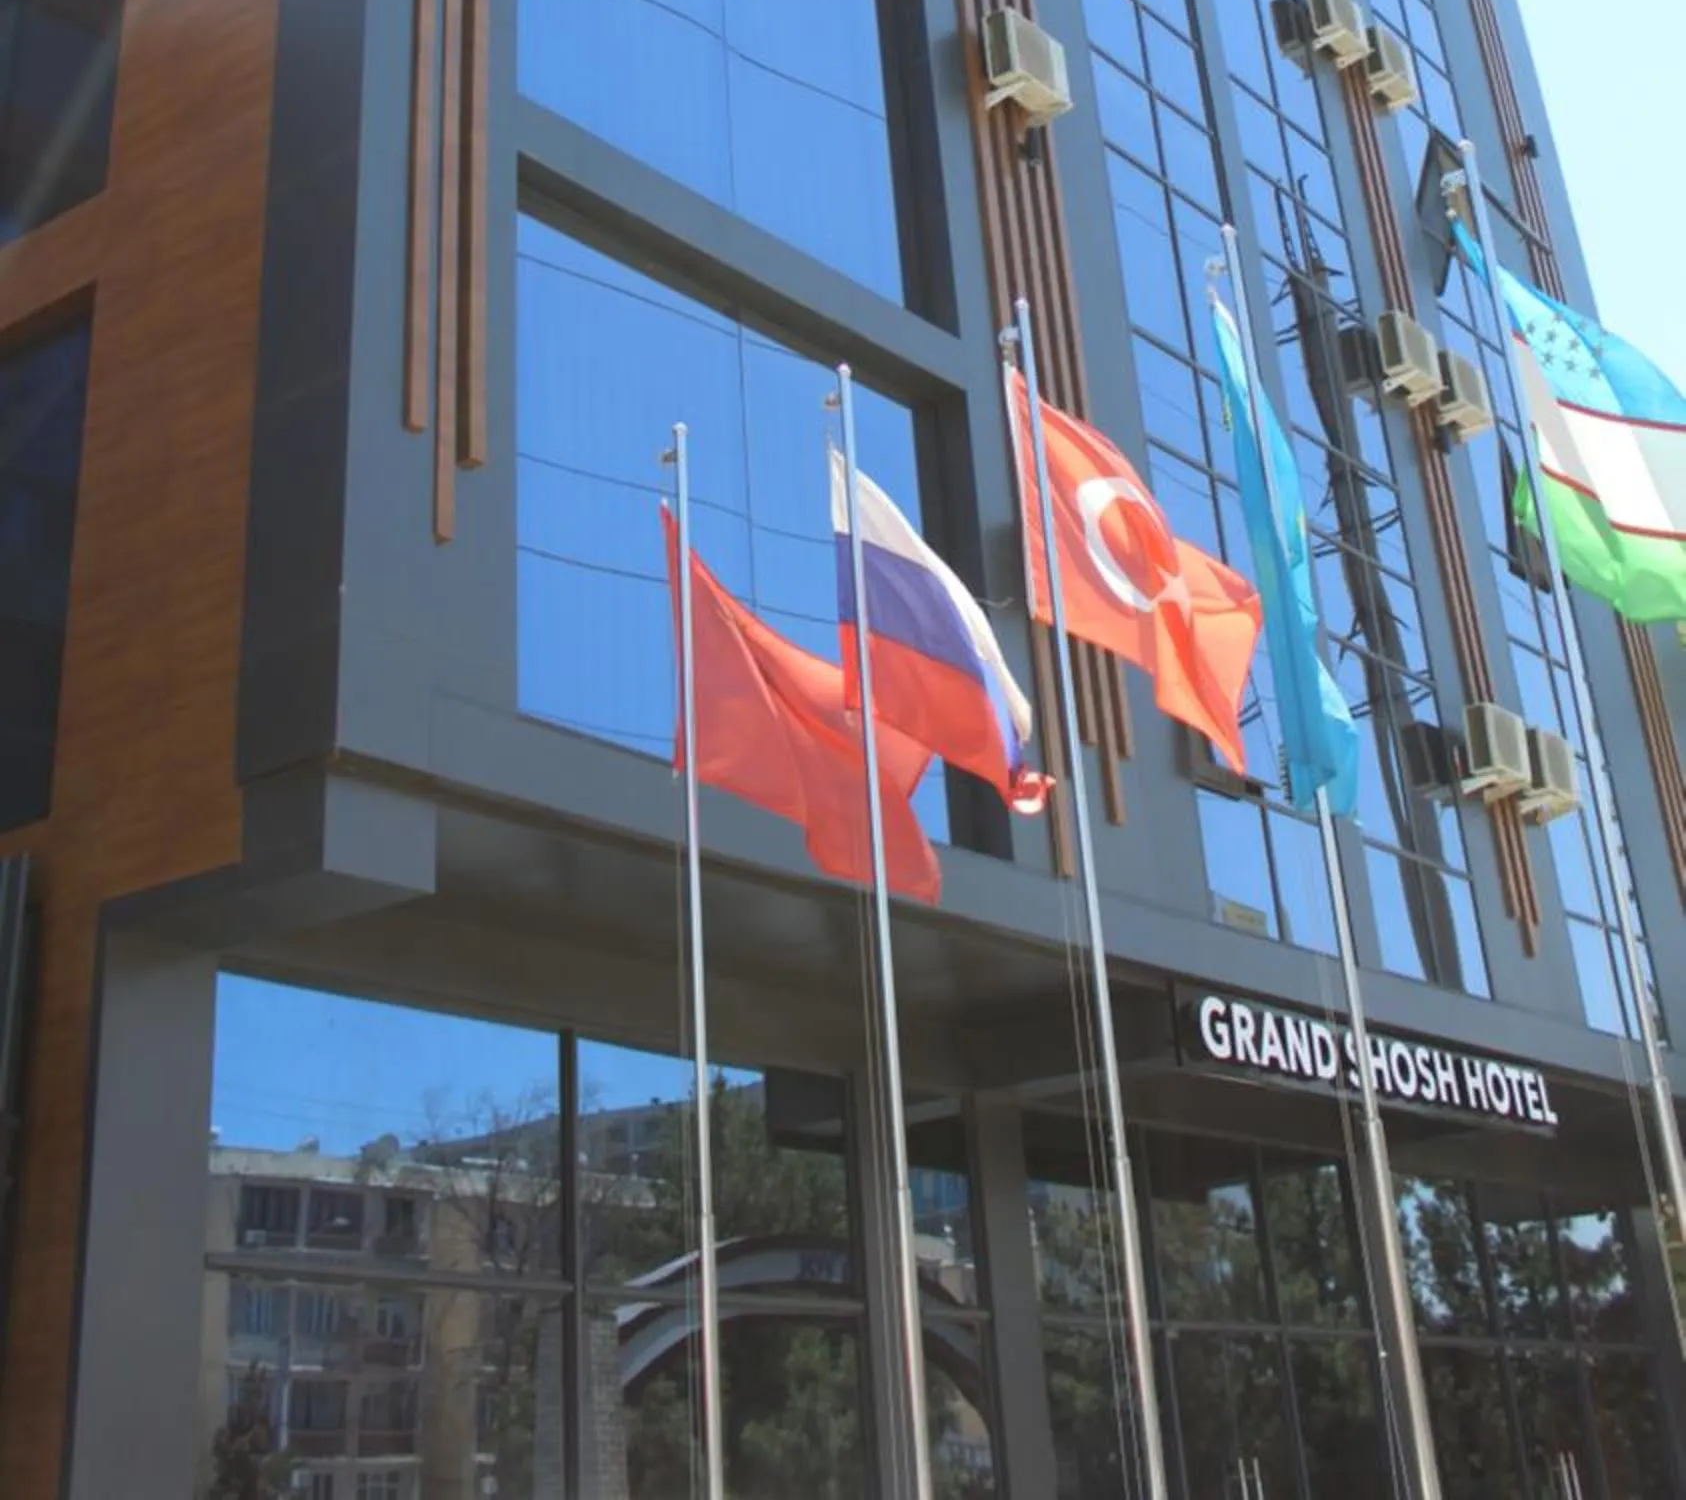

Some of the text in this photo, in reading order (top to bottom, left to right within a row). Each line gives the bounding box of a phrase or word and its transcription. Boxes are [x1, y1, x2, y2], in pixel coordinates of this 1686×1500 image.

[1201, 996, 1558, 1124] GRAND SHOSH HOTEL
